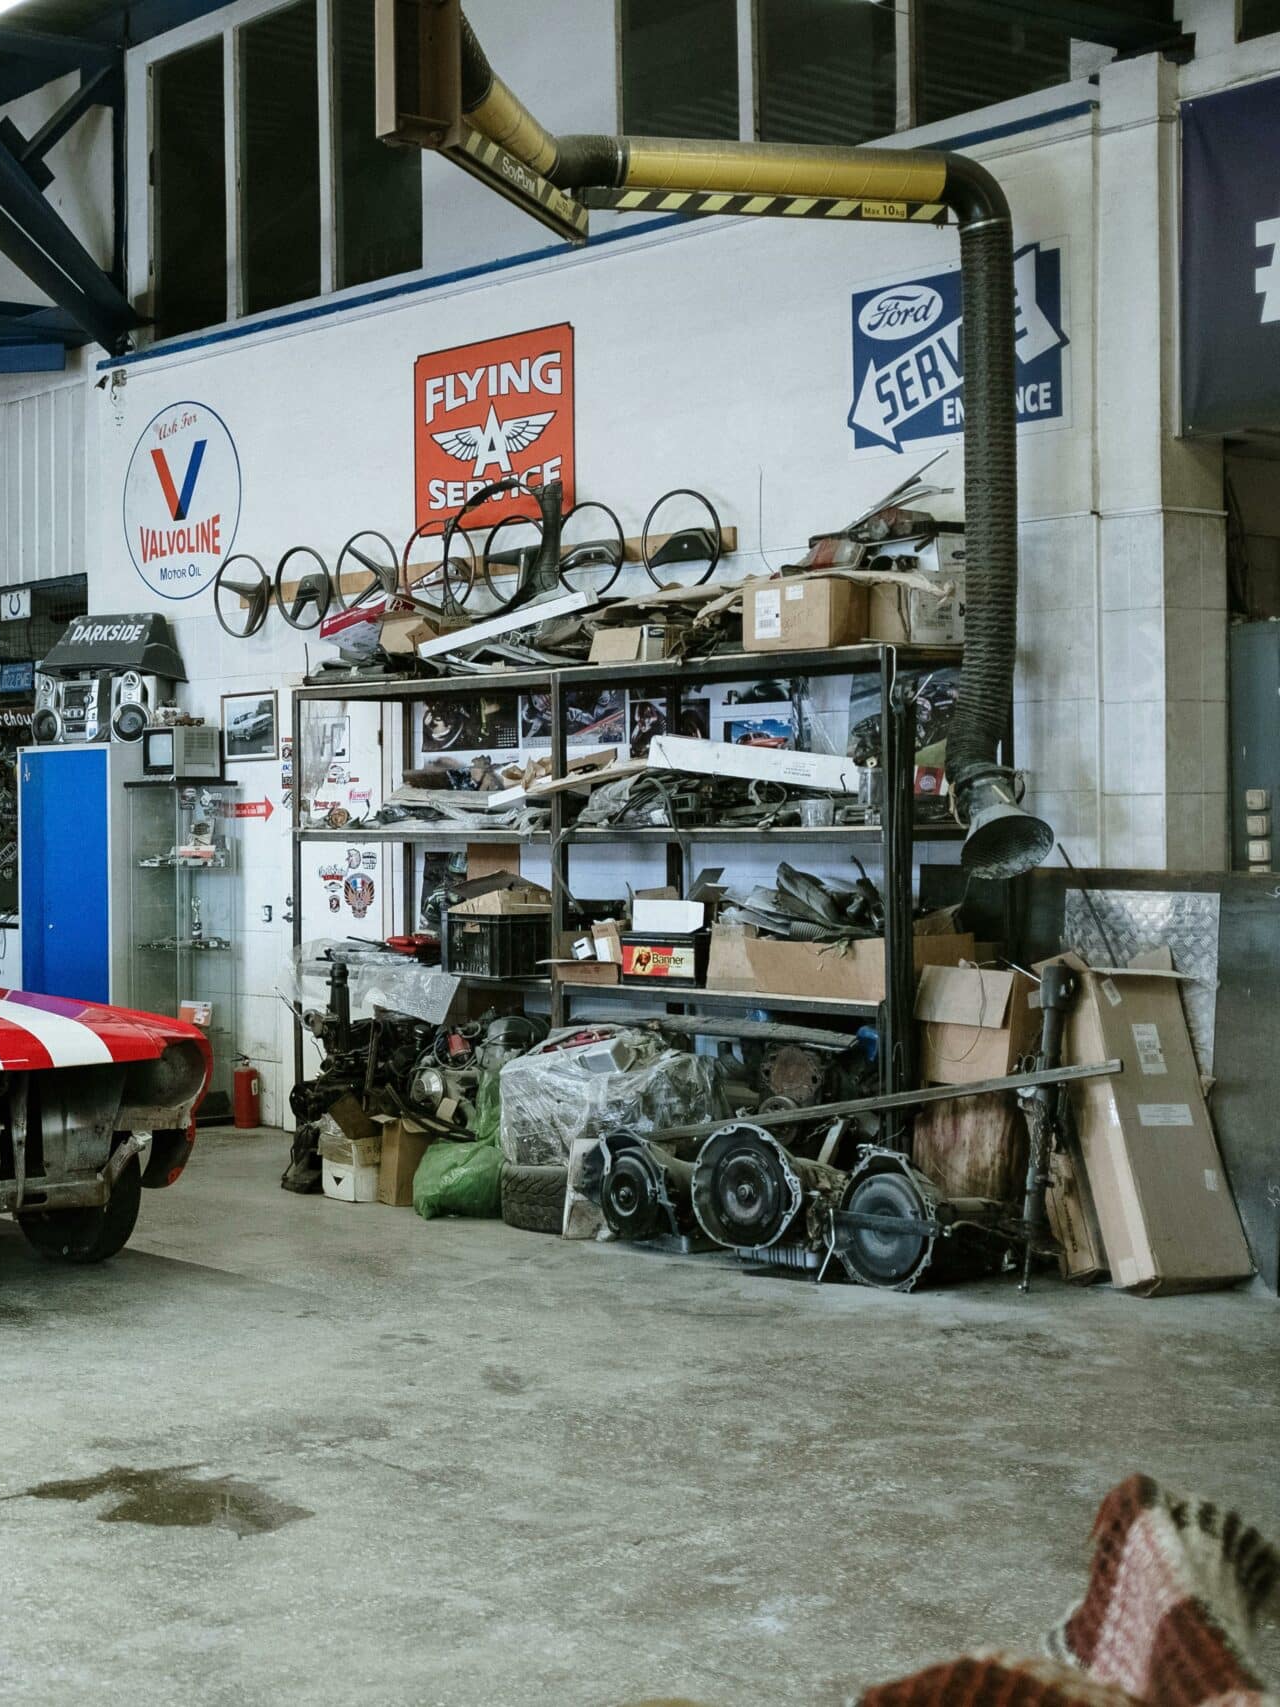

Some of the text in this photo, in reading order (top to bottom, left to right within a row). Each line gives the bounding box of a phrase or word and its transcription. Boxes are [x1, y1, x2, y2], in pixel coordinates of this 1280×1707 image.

[867, 294, 936, 331] Ford
[875, 287, 1029, 426] SERV
[425, 352, 562, 425] FLYING
[158, 412, 198, 441] Ask For
[472, 400, 512, 477] A
[140, 513, 221, 564] VALVOLINE
[71, 624, 145, 641] DARKSIDE
[651, 953, 685, 966] Banner
